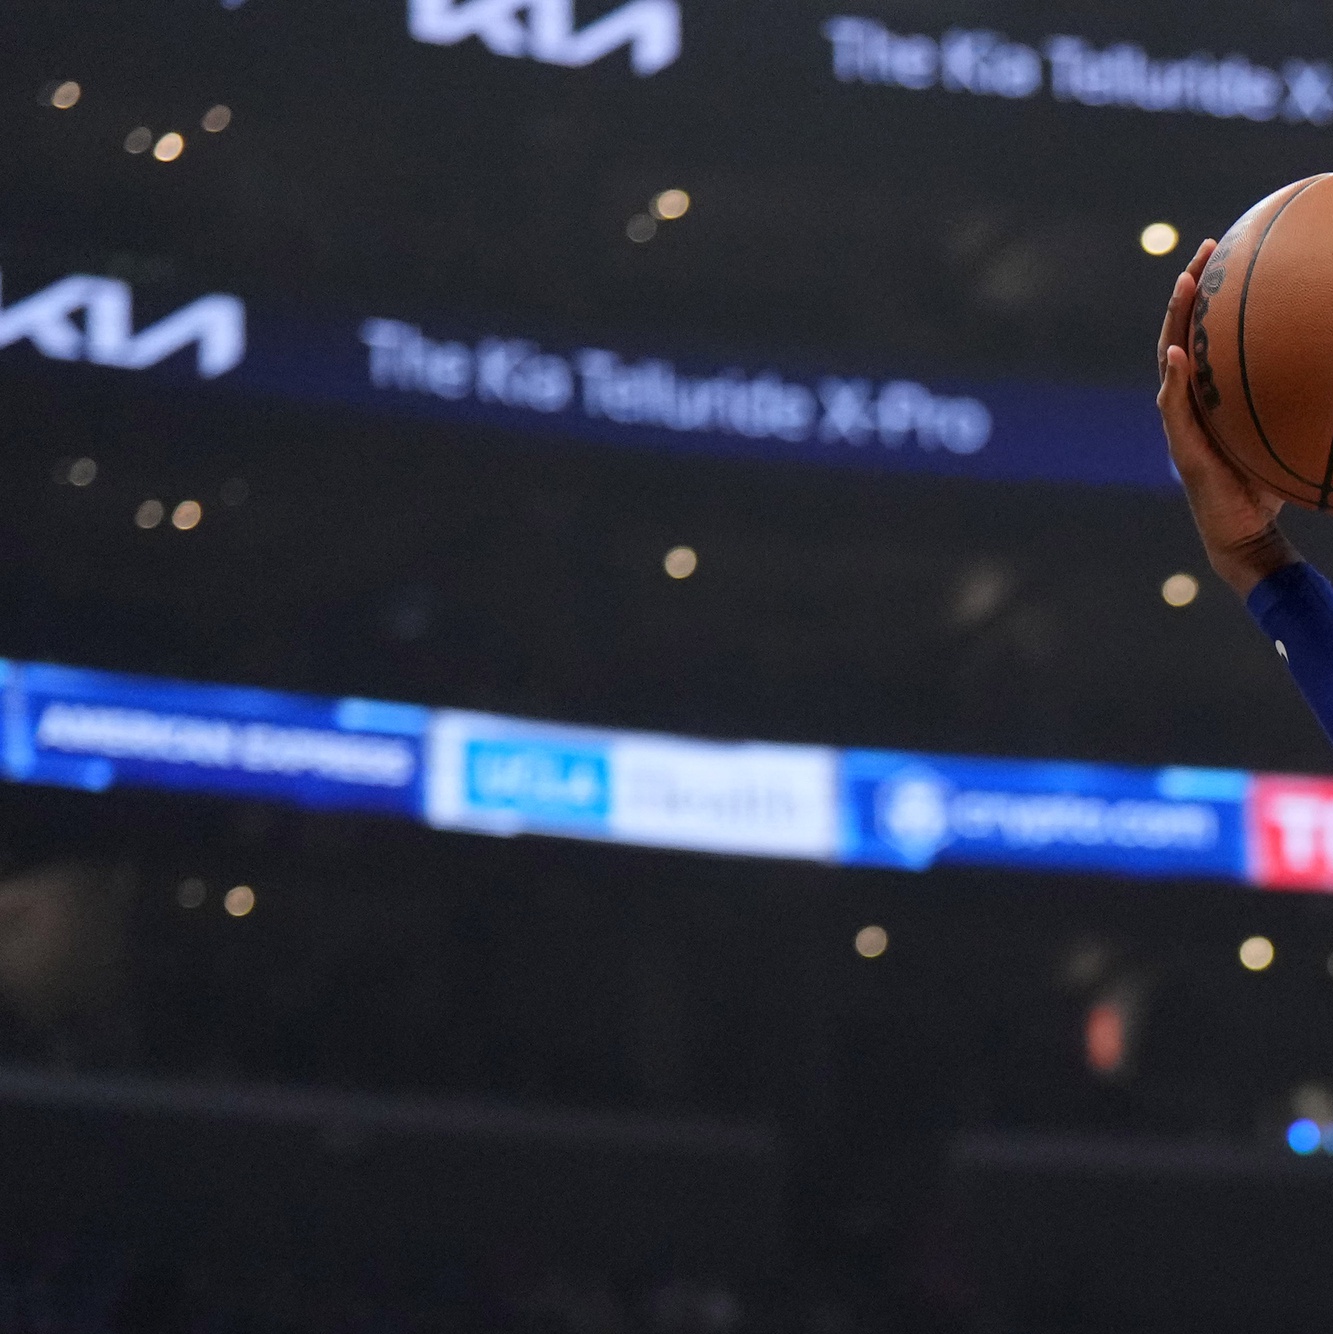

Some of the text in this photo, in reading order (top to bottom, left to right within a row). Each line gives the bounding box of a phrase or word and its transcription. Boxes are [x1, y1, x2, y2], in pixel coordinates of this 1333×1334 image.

[823, 16, 938, 90] The
[940, 26, 1042, 99] Kia
[1043, 34, 1284, 122] Telluride
[359, 316, 473, 400] The
[474, 335, 573, 412] Kia
[574, 347, 815, 442] Telluride
